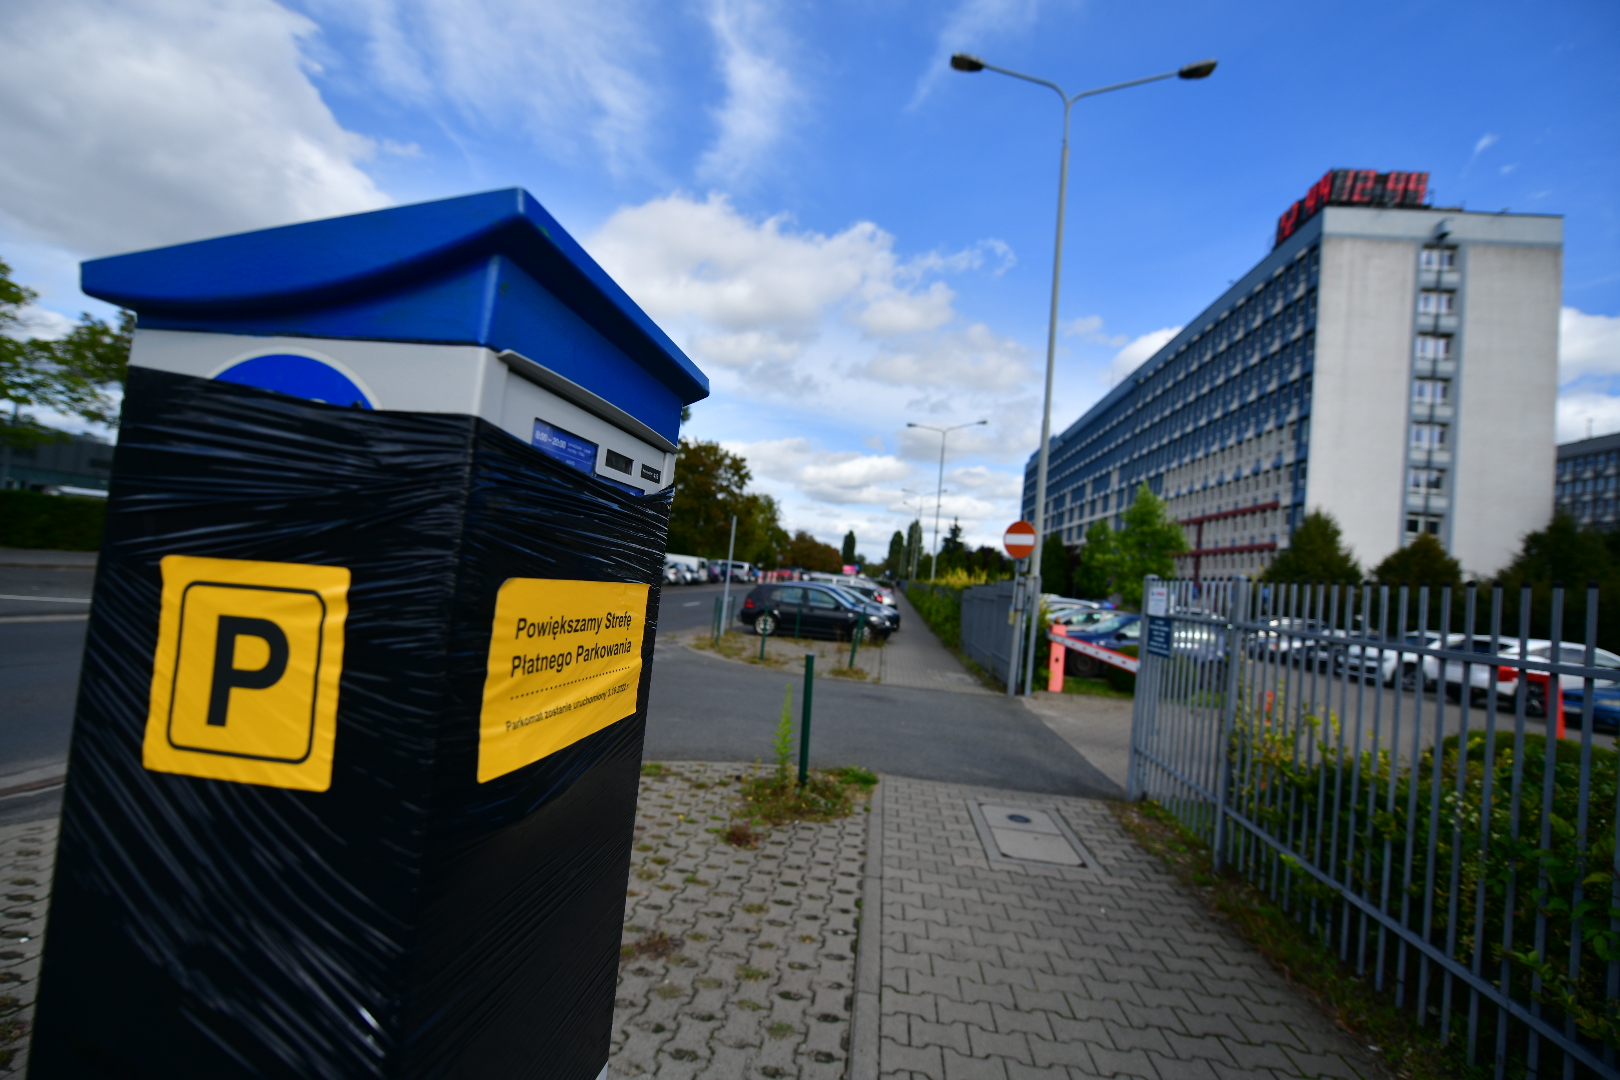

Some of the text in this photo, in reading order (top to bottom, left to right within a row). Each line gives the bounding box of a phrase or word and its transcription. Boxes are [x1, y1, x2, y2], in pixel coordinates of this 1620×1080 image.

[515, 610, 632, 640] Powiększamy Strefę
[206, 614, 290, 727] P
[510, 638, 632, 678] Płatnego Parkowania
[505, 710, 543, 732] Parkomat
[544, 702, 572, 719] zostanie
[573, 692, 606, 710] uruchomiony
